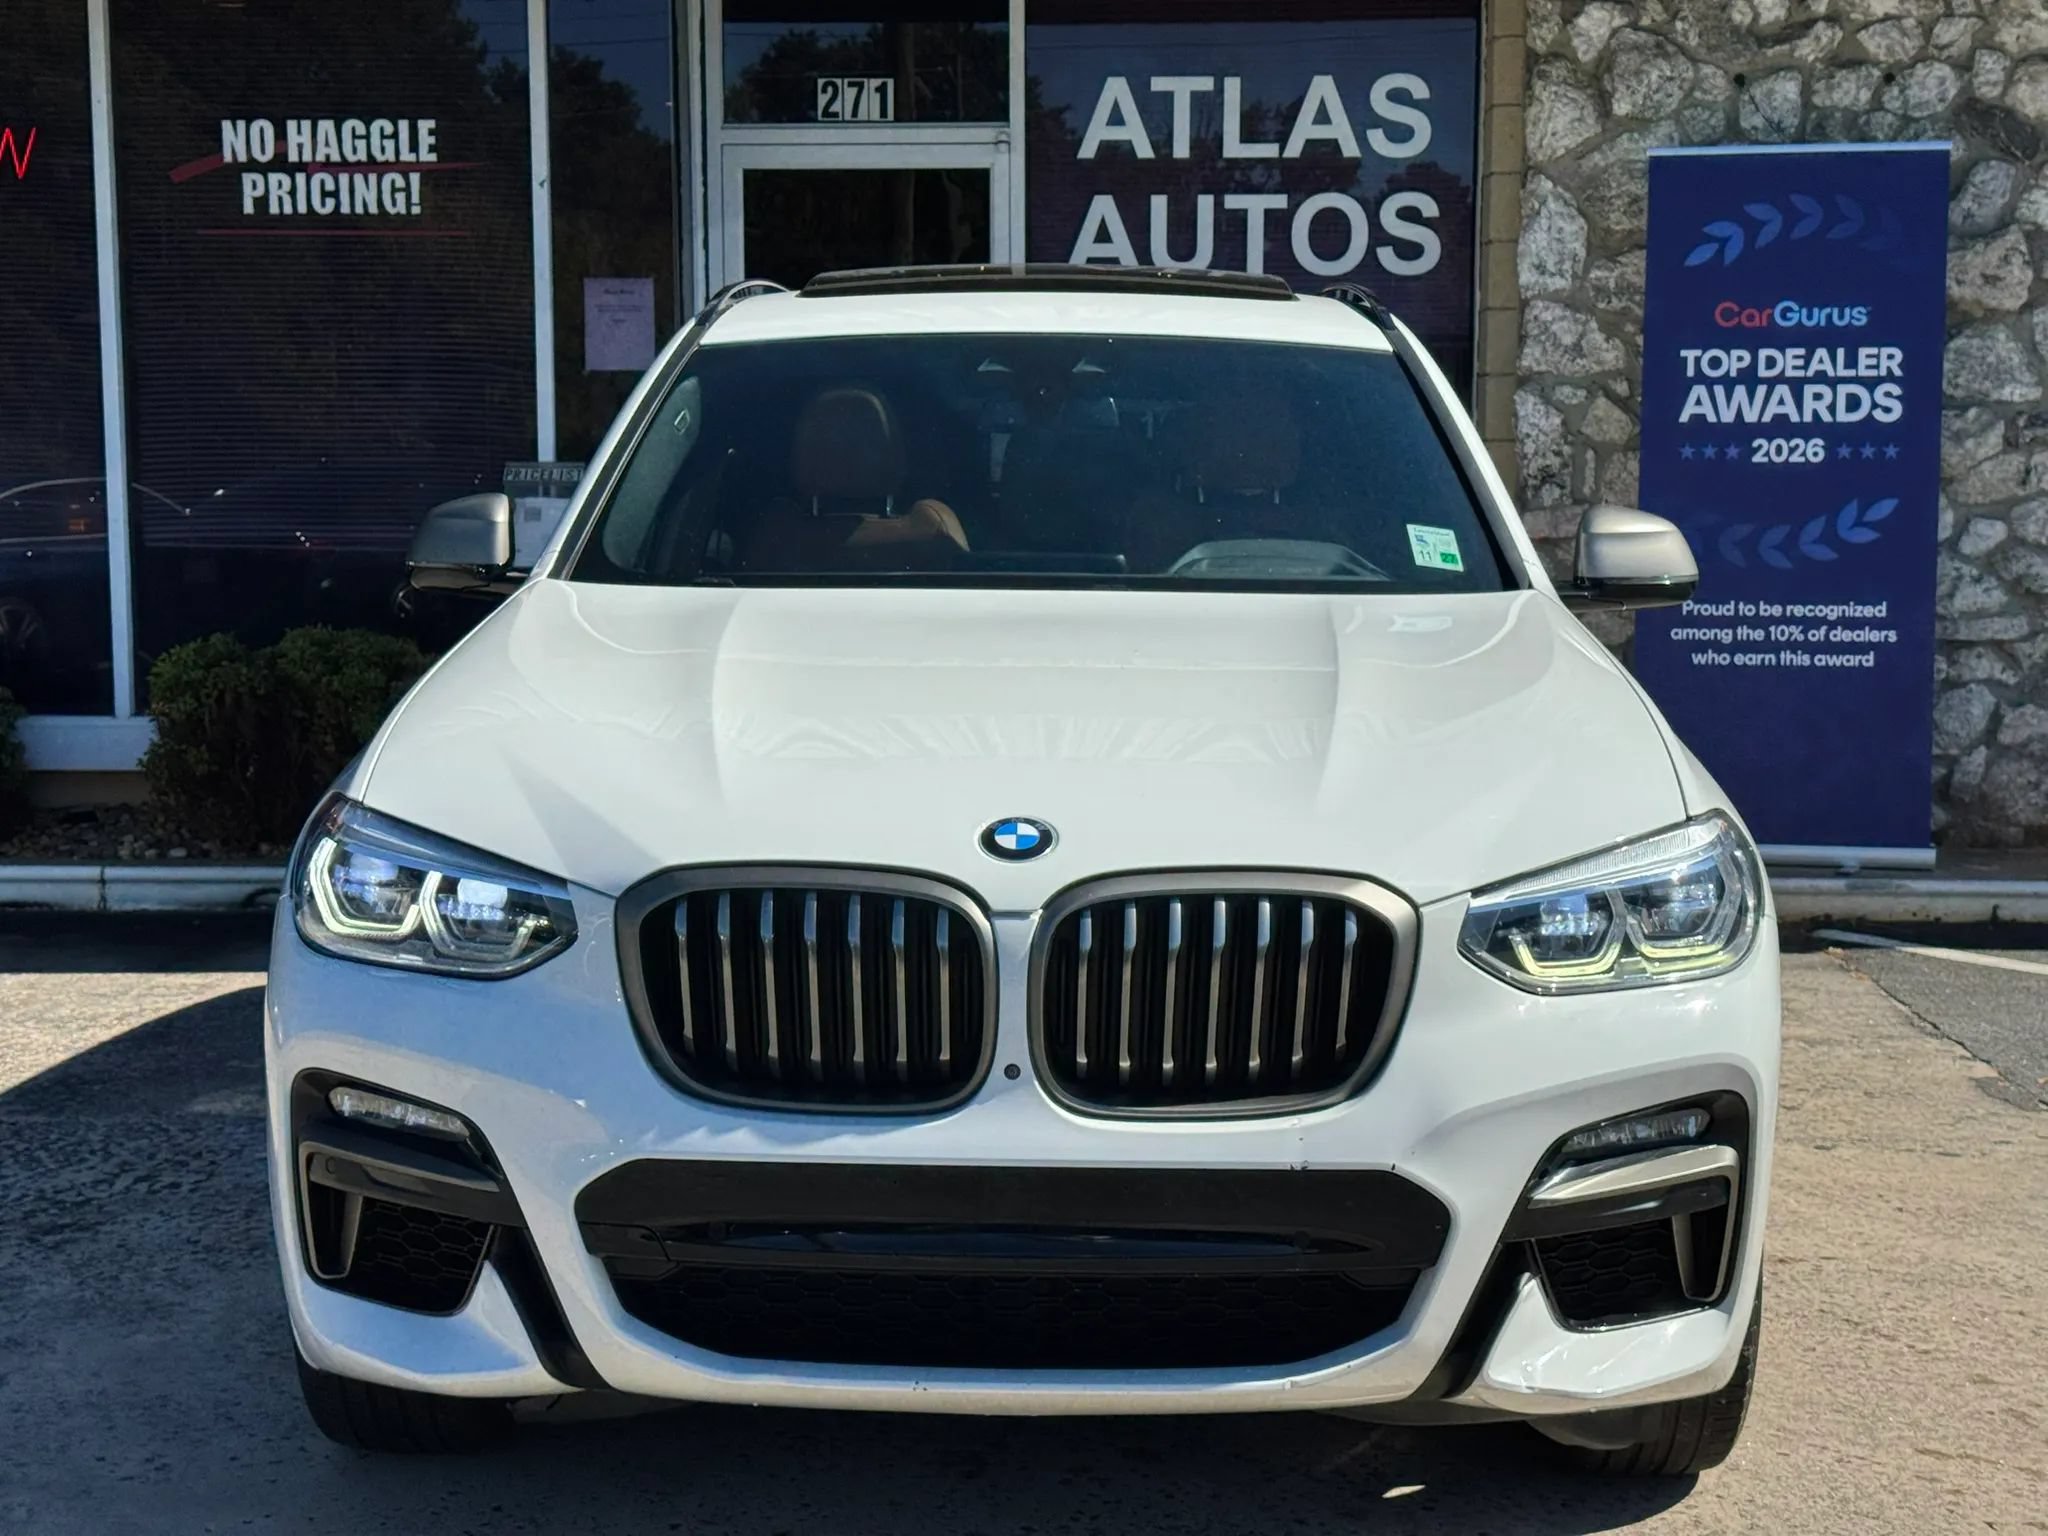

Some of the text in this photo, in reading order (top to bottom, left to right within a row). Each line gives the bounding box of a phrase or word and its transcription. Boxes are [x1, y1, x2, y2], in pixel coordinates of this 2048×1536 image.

[820, 79, 891, 120] 271
[1076, 73, 1432, 160] ATLAS
[221, 119, 438, 163] NO HAGGLE
[241, 172, 422, 216] PRICING!
[1068, 191, 1443, 277] AUTOS
[1714, 300, 1868, 328] CarGurus
[1680, 347, 1904, 378] TOP DEALER
[1678, 383, 1904, 423] AWARDS
[1751, 438, 1826, 464] 2026
[1682, 600, 1887, 621] Proud to be recognized
[1670, 625, 1897, 644] among the 10% of dealers
[1691, 649, 1874, 667] who earn this award
